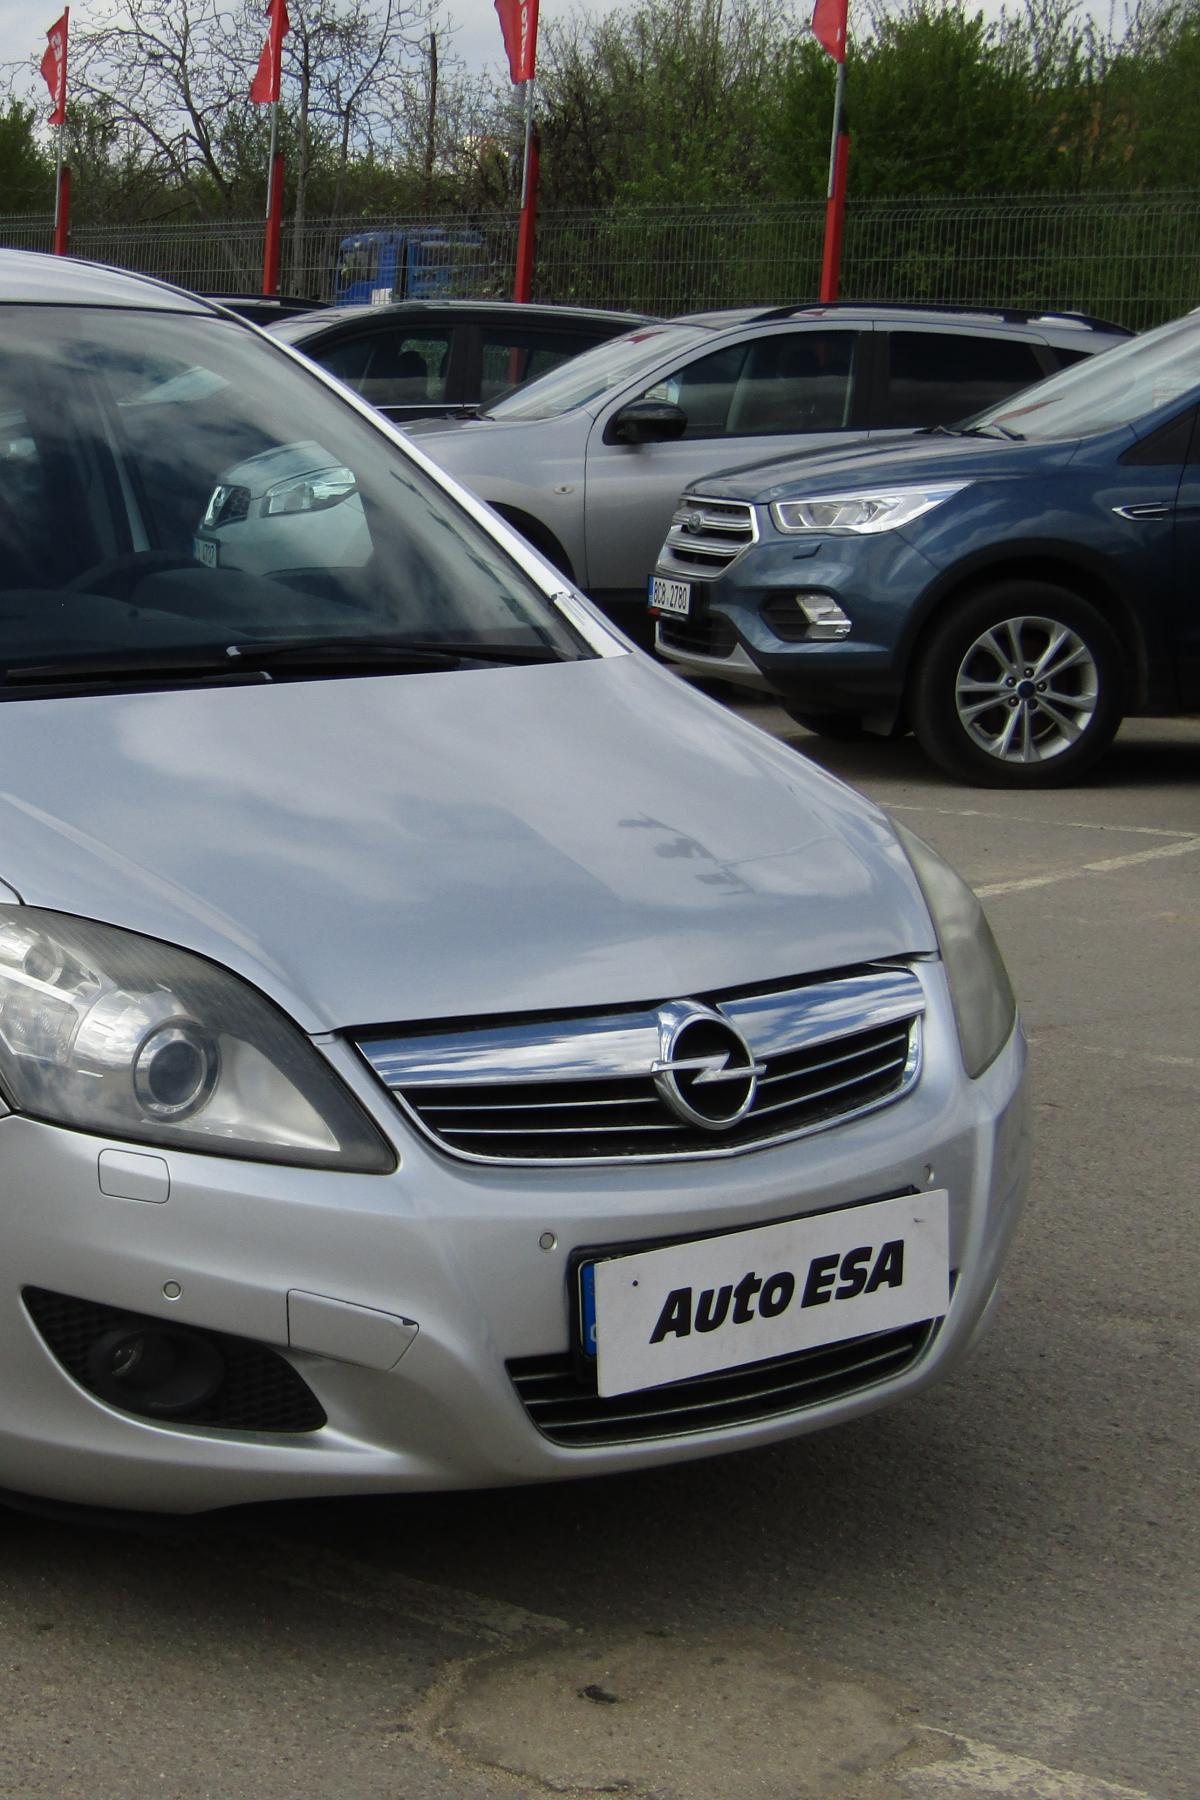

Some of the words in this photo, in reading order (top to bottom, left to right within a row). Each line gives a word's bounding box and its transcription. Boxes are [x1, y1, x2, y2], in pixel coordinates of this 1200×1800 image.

[670, 584, 687, 609] 2780
[649, 1271, 795, 1344] Auto
[801, 1239, 904, 1308] ESA
